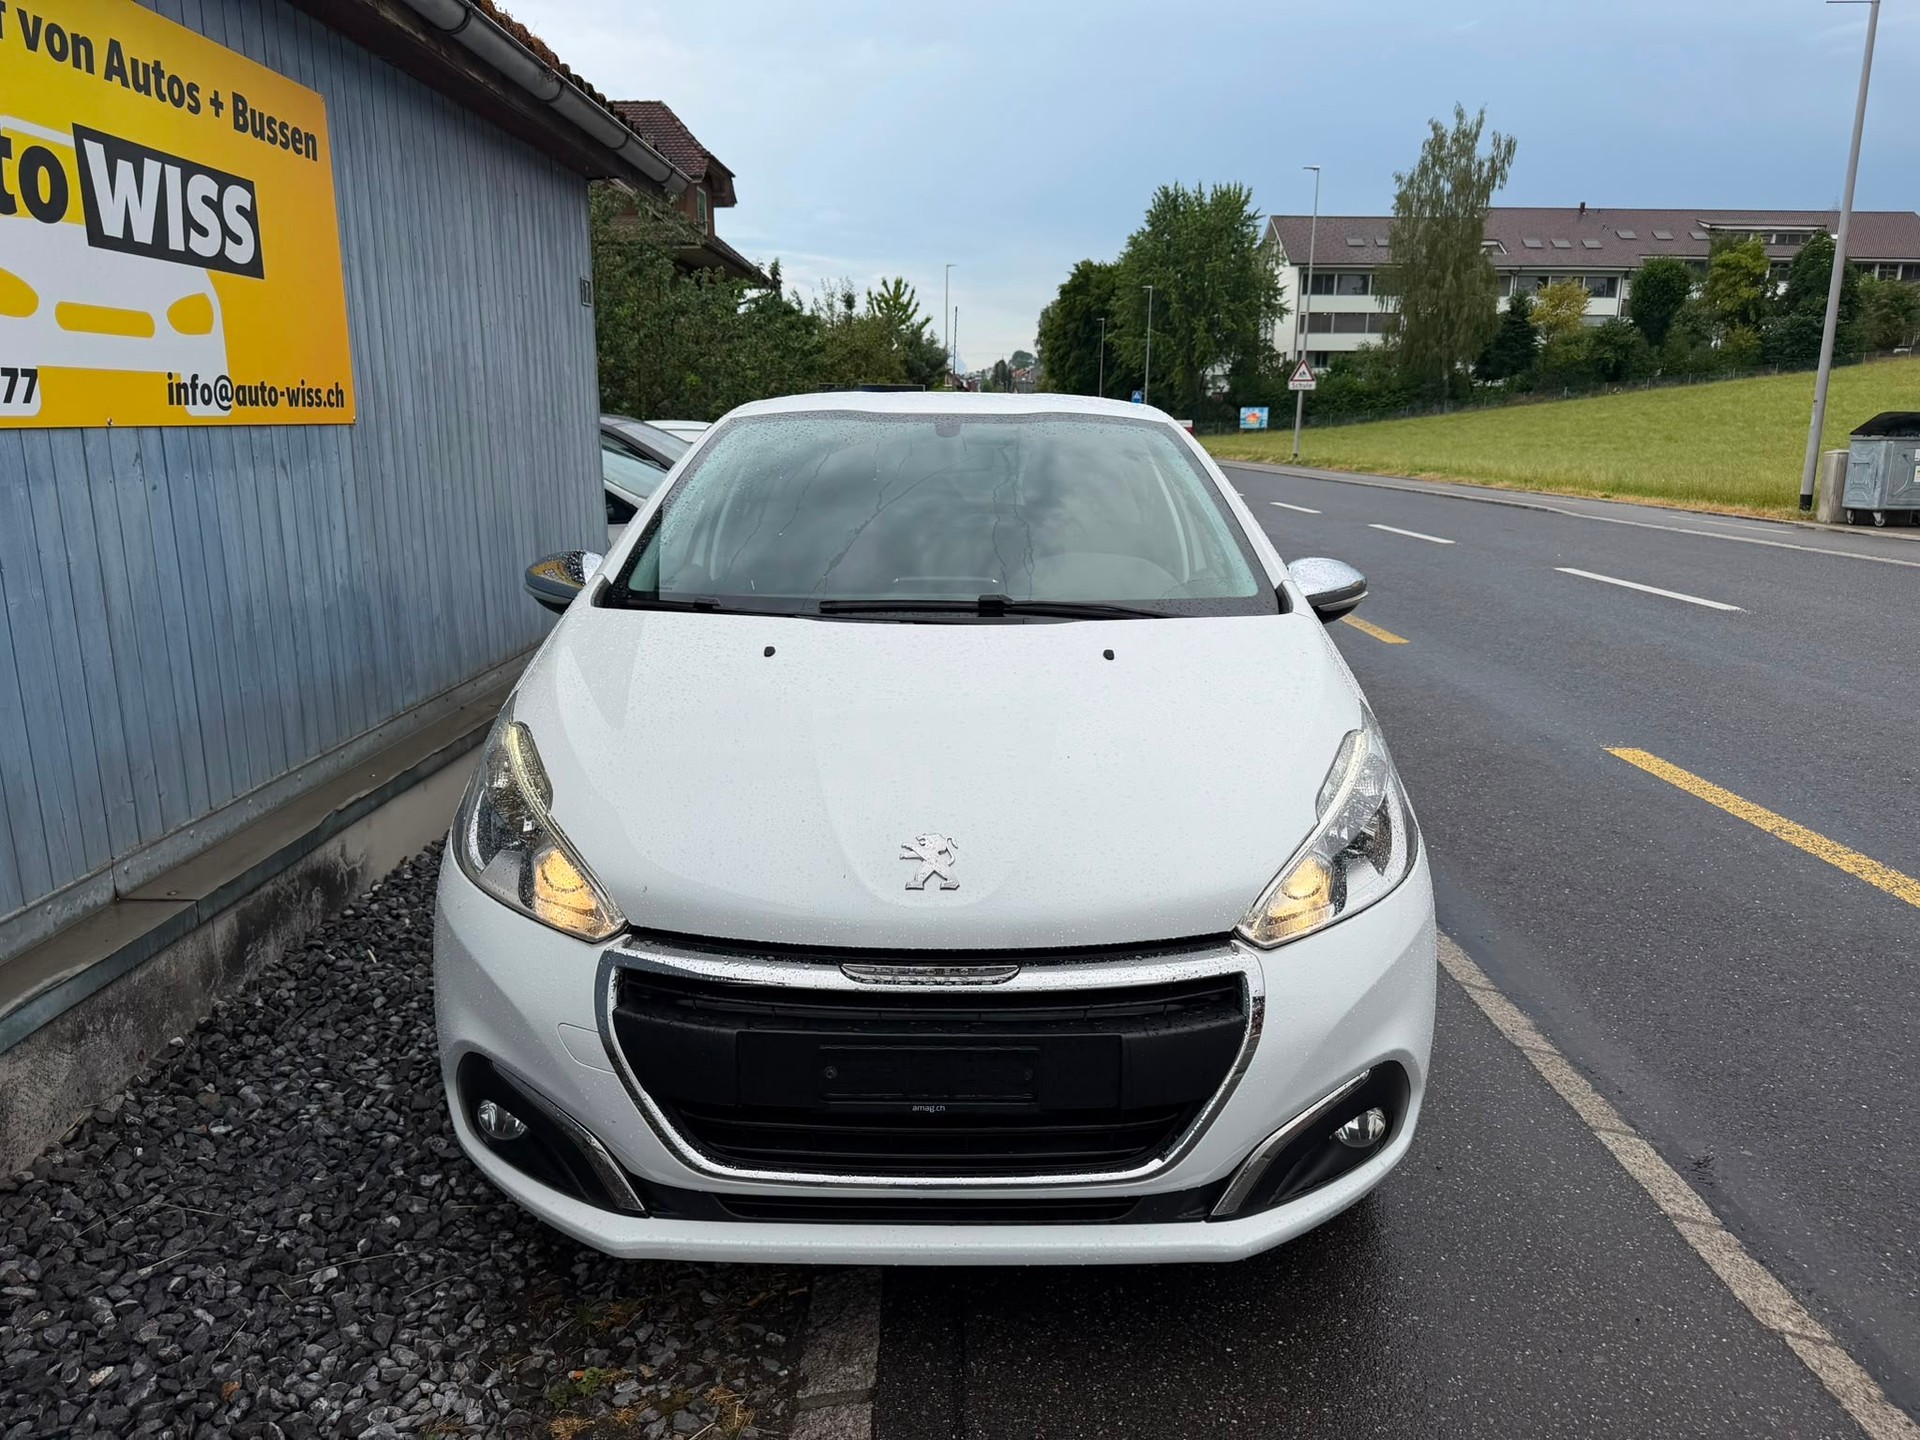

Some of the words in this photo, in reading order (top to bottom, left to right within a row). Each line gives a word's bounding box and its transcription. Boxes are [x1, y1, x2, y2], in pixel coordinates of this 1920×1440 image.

[17, 8, 94, 75] von
[104, 38, 200, 115] Autos
[210, 90, 224, 118] +
[232, 91, 318, 162] Bussen
[83, 138, 256, 265] WISS
[0, 367, 38, 404] 77
[167, 372, 345, 411] info@auto-wiss.ch
[912, 1105, 946, 1113] amag.ch
